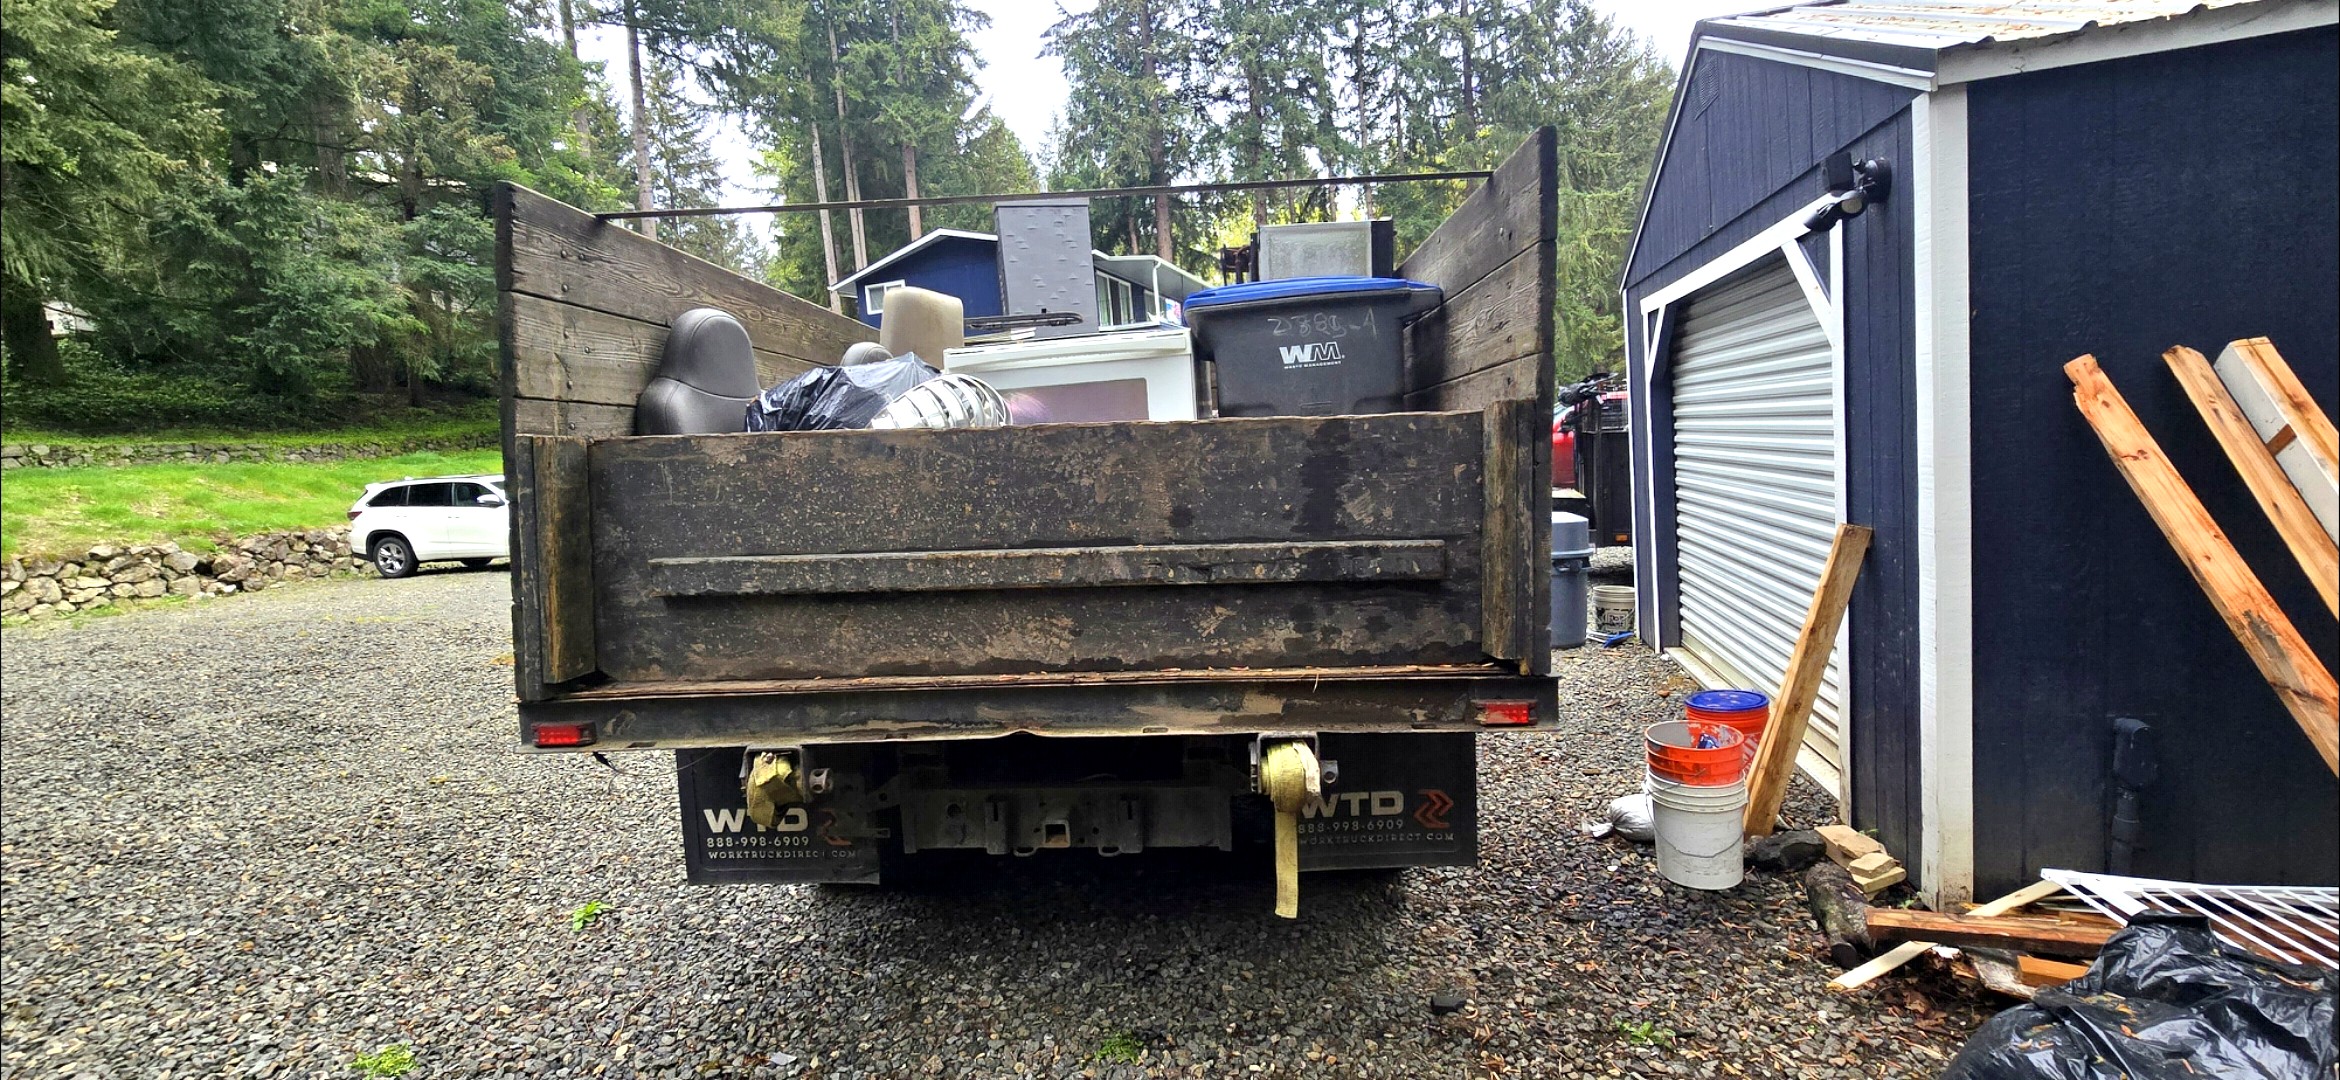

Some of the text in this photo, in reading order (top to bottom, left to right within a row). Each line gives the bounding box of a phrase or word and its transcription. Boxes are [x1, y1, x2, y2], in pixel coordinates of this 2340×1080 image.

[1279, 341, 1342, 364] WM
[1301, 790, 1405, 819] WTD
[703, 807, 809, 833] WD
[1298, 819, 1404, 834] 888-998-6909
[706, 836, 810, 848] 888-998-6909
